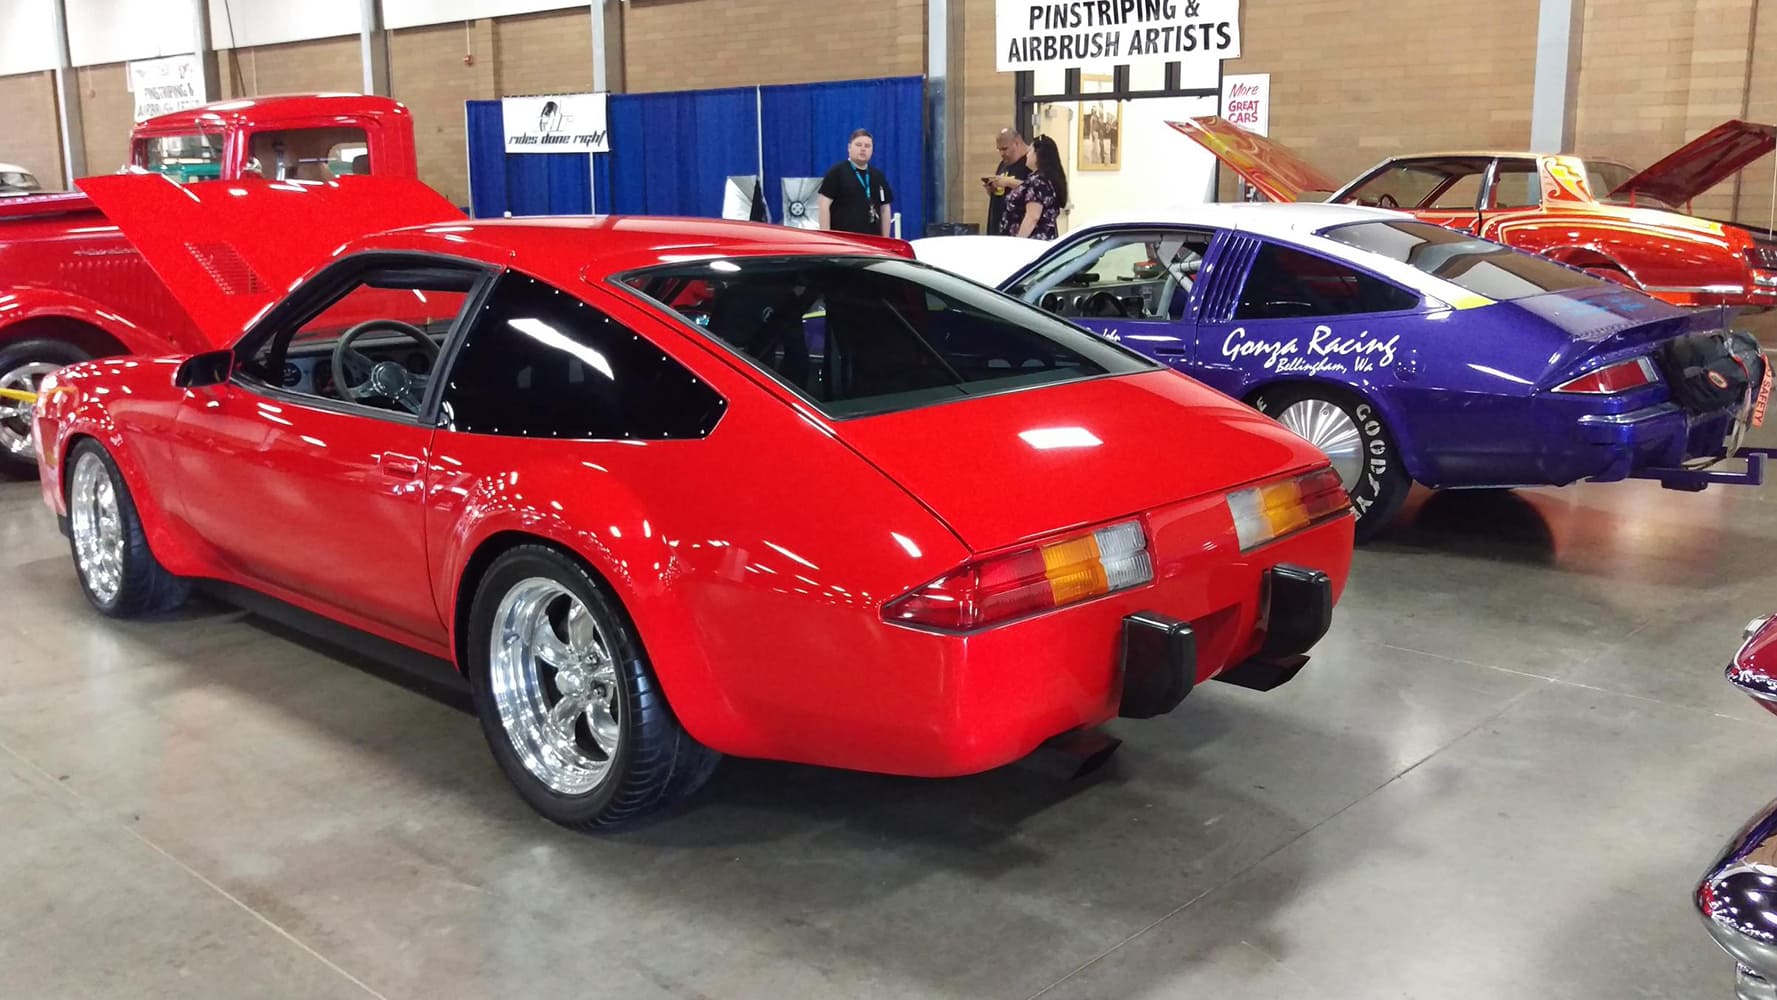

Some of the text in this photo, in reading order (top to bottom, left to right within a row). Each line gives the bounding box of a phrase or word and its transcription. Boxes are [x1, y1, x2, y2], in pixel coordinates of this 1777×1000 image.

[1029, 0, 1200, 30] PINSTRIPING &
[1008, 21, 1231, 63] AIRBRUSH ARTISTS
[1229, 83, 1259, 98] More
[1228, 100, 1259, 112] GREAT
[1228, 112, 1258, 123] CARS
[509, 130, 606, 147] rides done right
[1222, 325, 1400, 369] Gonza Racing
[1275, 356, 1373, 376] Bellingham, Wa
[1754, 381, 1770, 423] SAFETY
[1349, 403, 1386, 522] GOODYE
